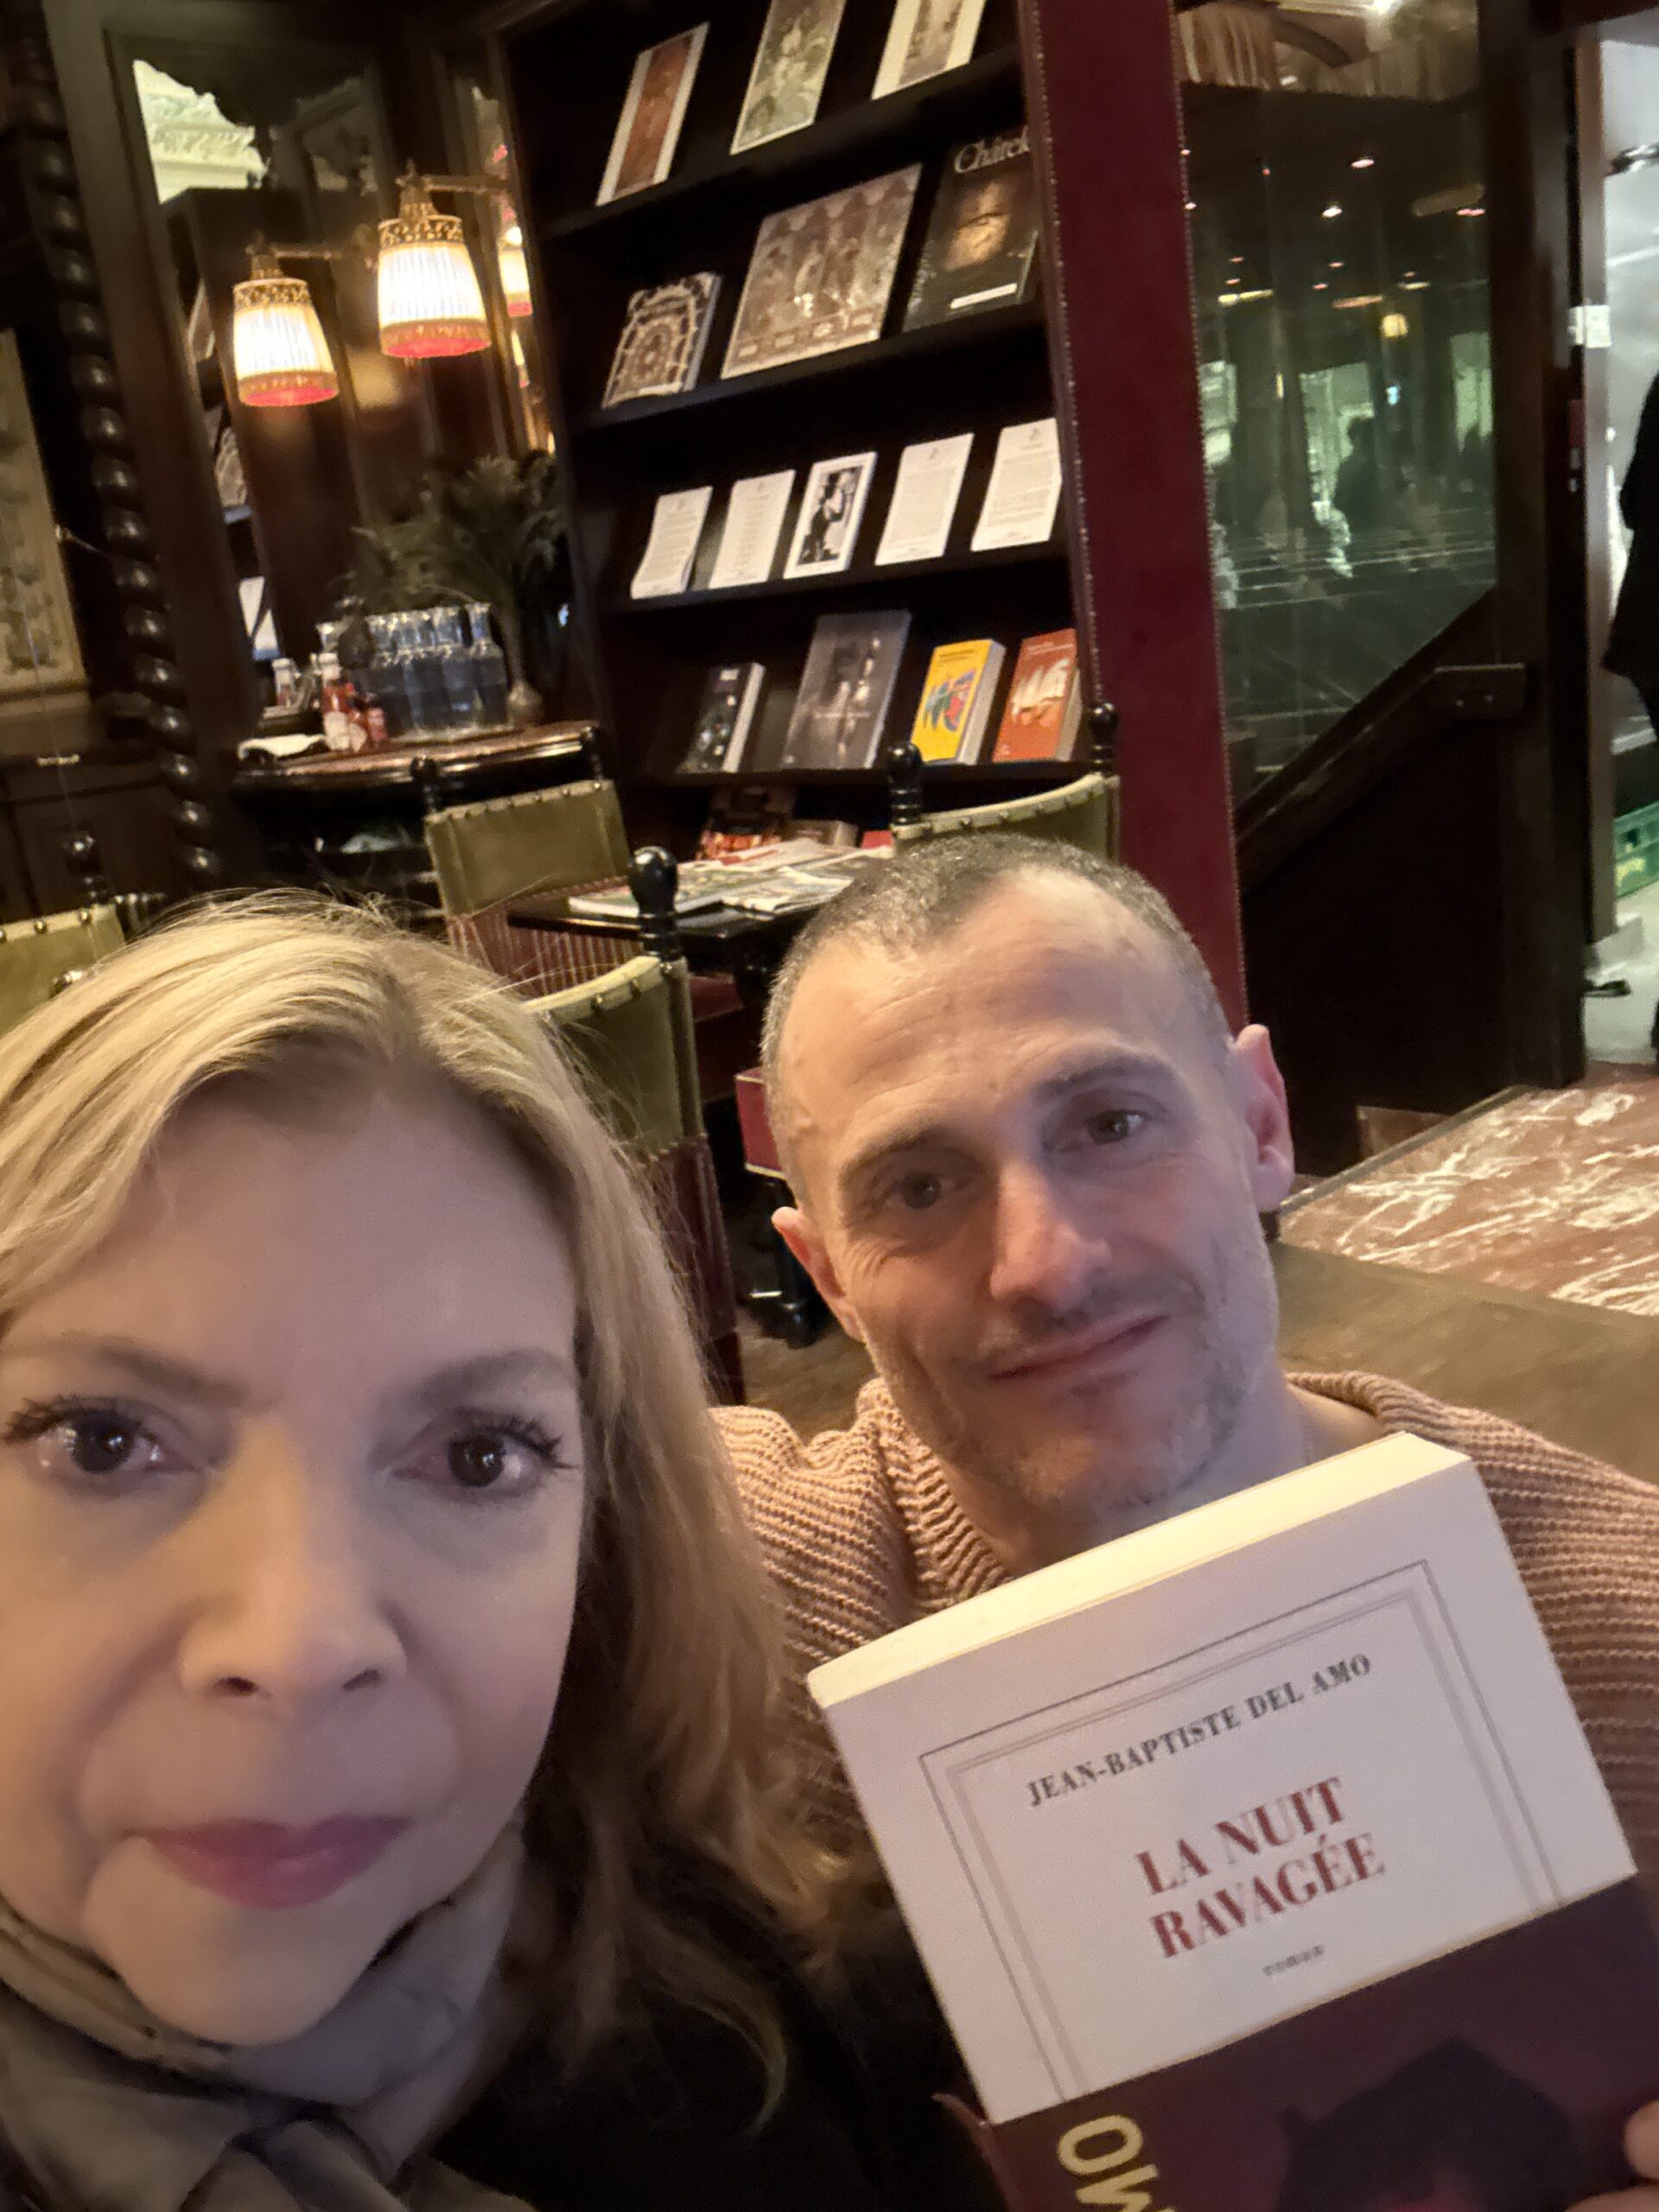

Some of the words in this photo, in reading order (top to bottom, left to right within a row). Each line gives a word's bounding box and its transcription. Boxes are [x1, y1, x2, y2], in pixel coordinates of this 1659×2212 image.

[1027, 1704, 1241, 1807] JEAN-BAPTISTE
[1244, 1681, 1305, 1719] DEL
[1312, 1652, 1372, 1695] AMO
[1134, 1837, 1211, 1896] LA
[1213, 1776, 1345, 1866] NUIT
[1149, 1831, 1386, 1959] RAVAGÉE
